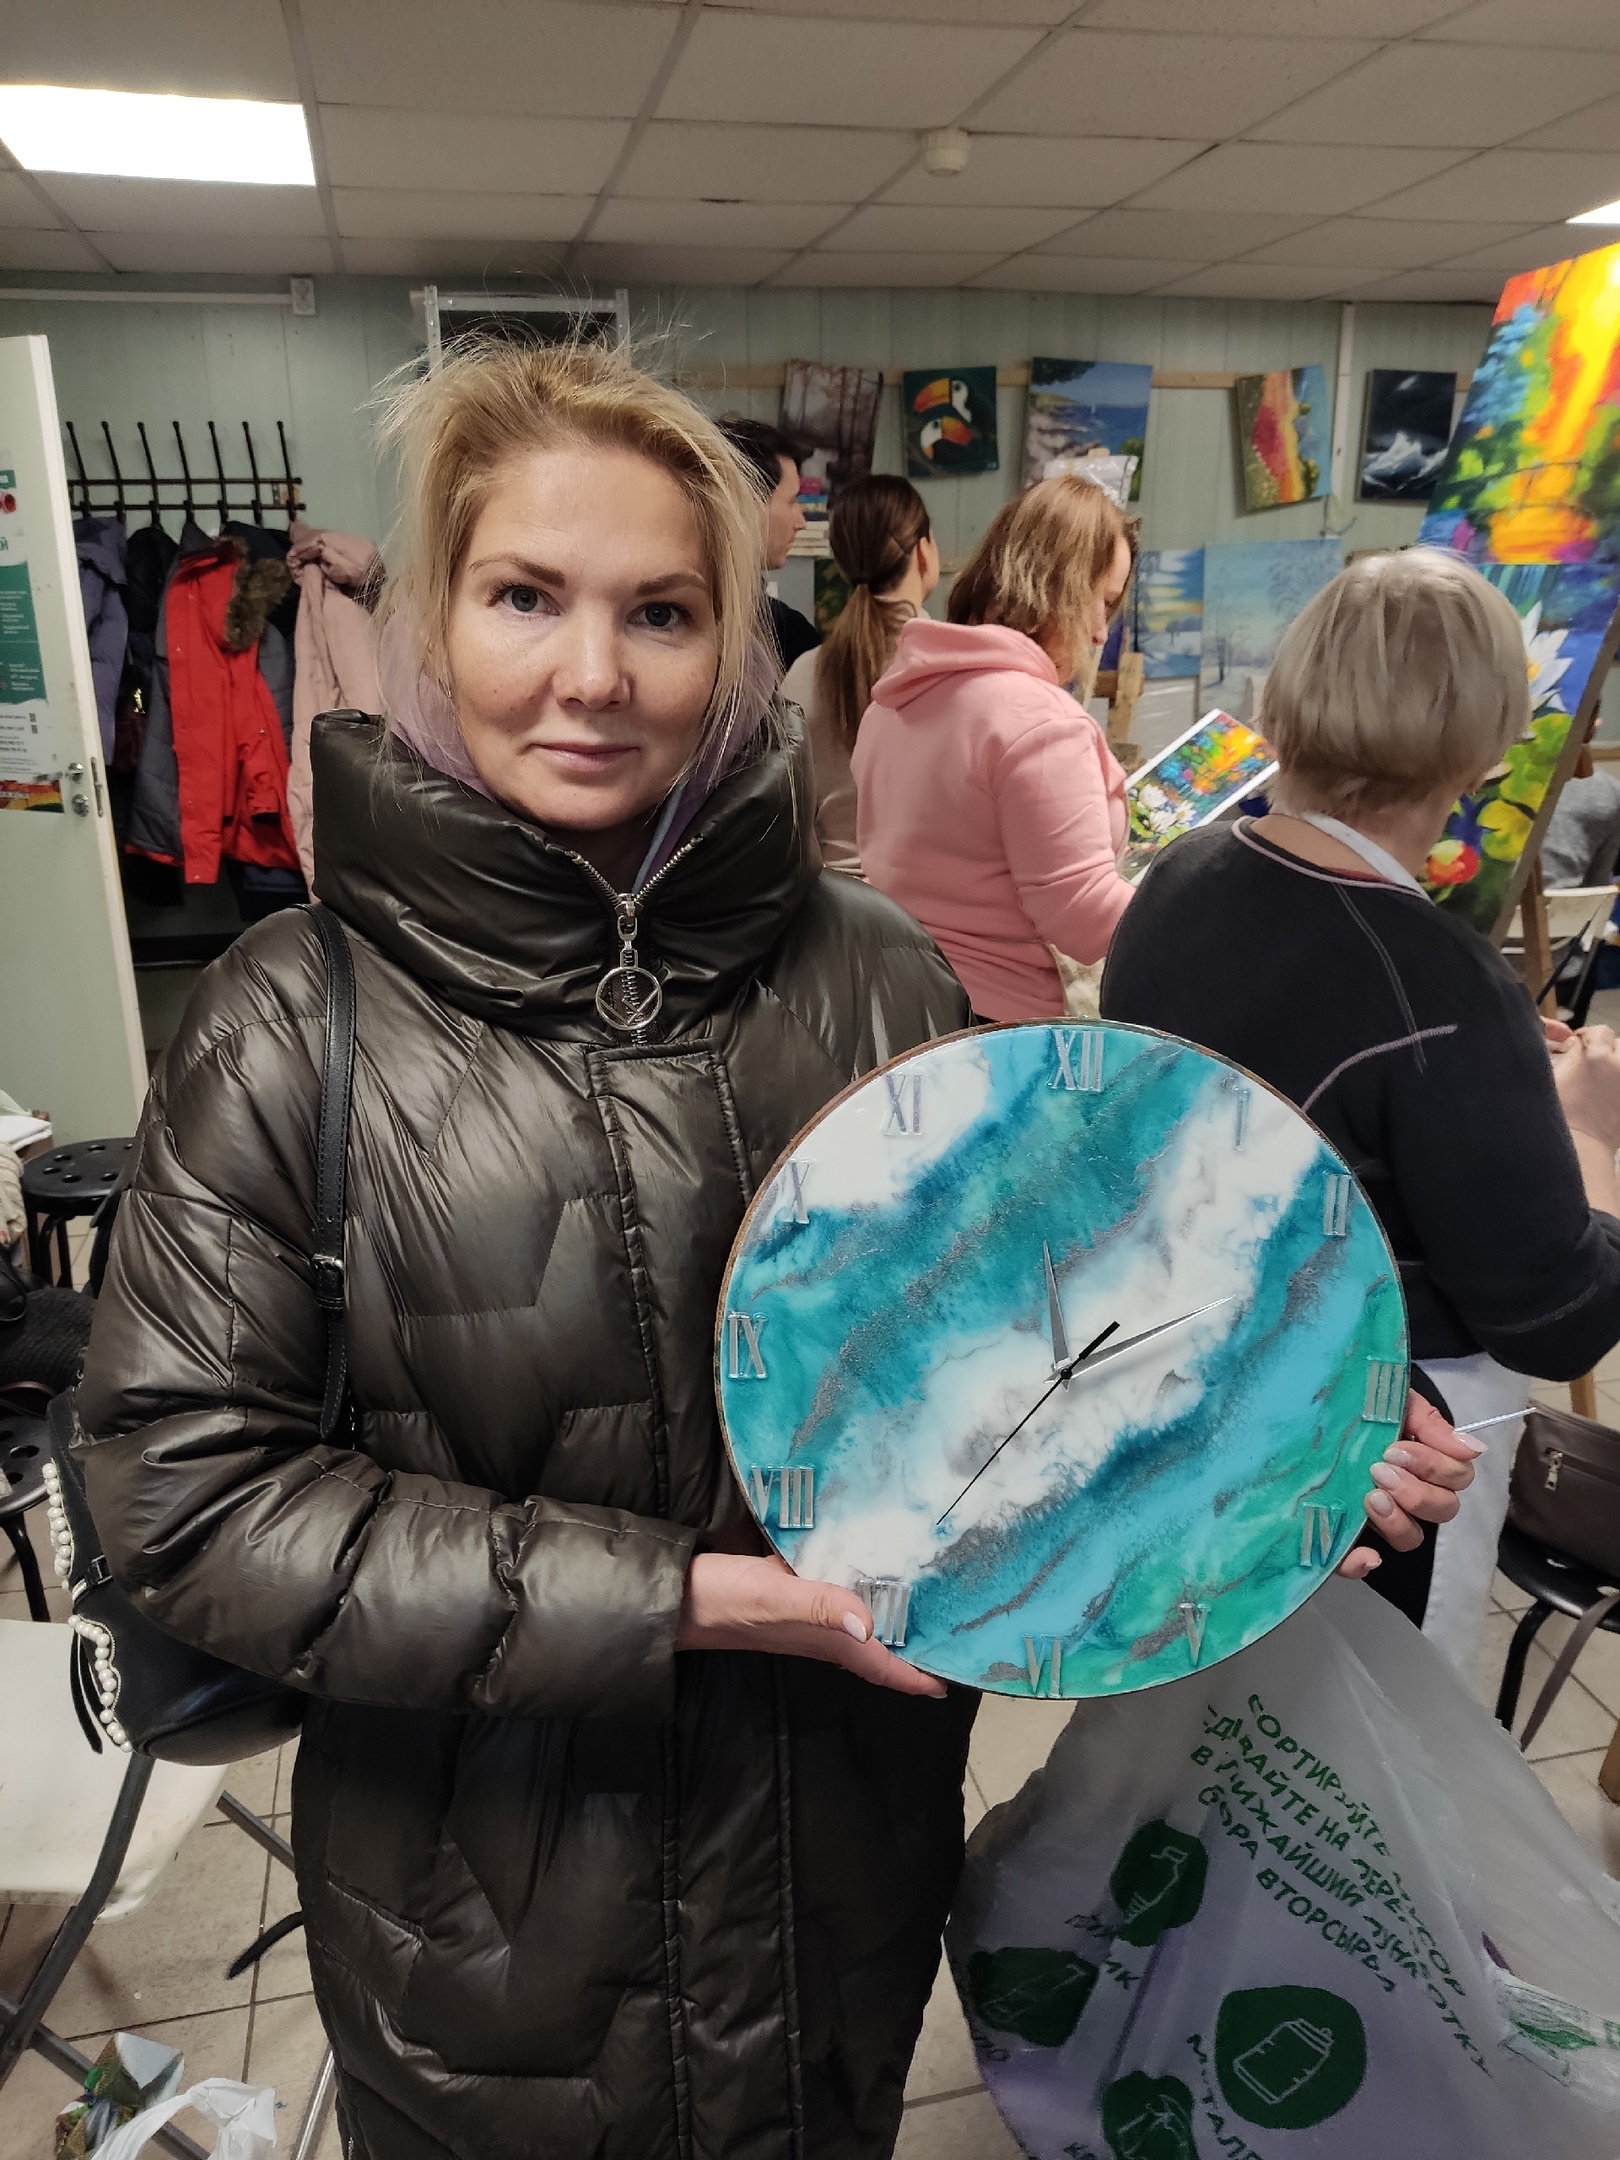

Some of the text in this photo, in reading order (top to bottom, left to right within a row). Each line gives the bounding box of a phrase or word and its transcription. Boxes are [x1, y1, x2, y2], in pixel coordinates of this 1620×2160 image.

[1048, 1029, 1104, 1091] XII
[883, 1073, 923, 1136] XI
[782, 1158, 815, 1225] X
[1322, 1173, 1353, 1236] II
[728, 1311, 769, 1379] IX
[1362, 1358, 1400, 1423] III
[750, 1465, 815, 1529] VIII
[1300, 1501, 1347, 1566] IV
[1023, 1633, 1062, 1698] VI
[1179, 1603, 1210, 1667] V
[1203, 1704, 1320, 1826] ДАВАЙТЕ
[1315, 1816, 1351, 1852] НА
[1190, 1745, 1214, 1766] В
[1214, 1752, 1365, 1908] ИЖАЙШИЙ
